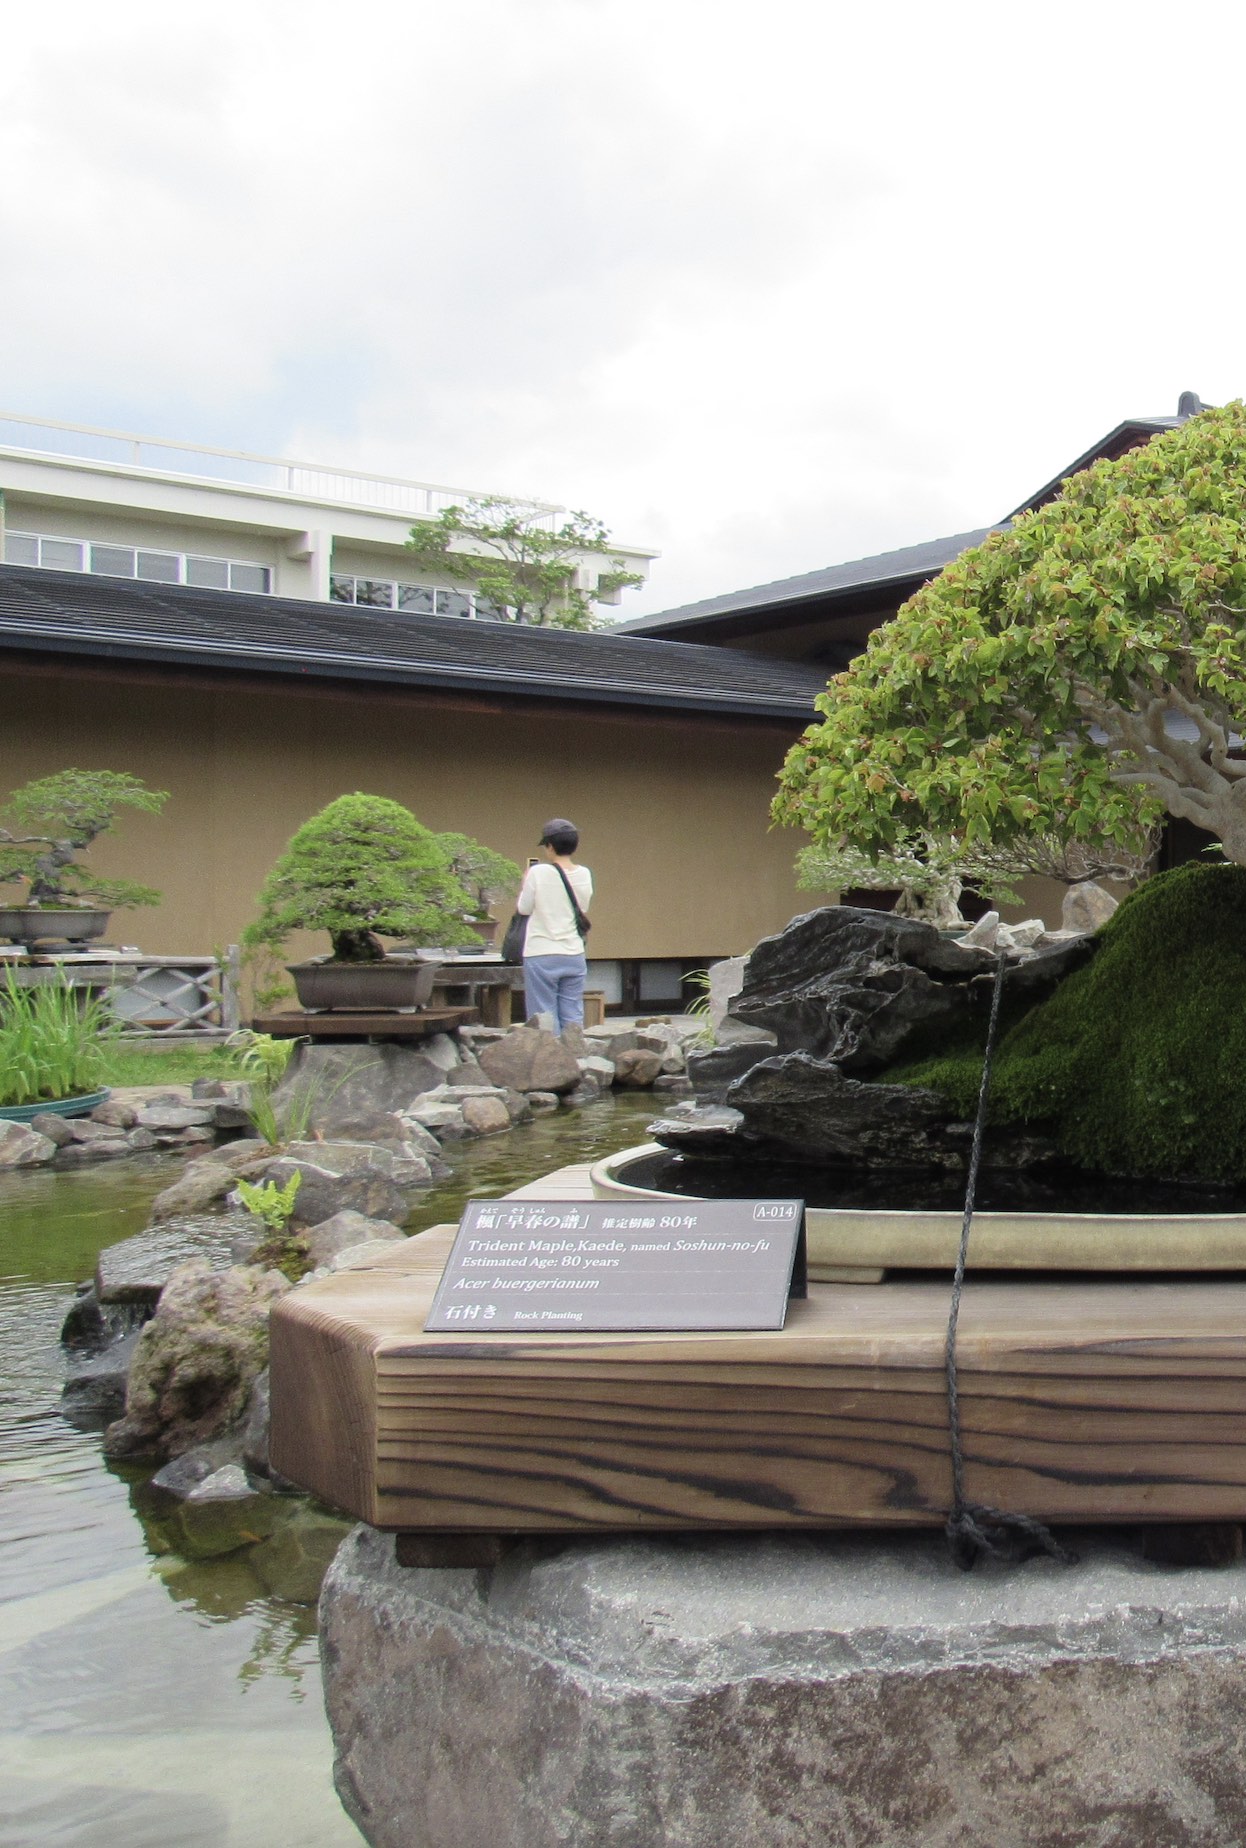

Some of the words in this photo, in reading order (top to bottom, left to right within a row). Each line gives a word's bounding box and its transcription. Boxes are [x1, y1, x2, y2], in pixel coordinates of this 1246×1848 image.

[756, 1206, 794, 1218] A-014
[468, 1240, 525, 1252] Trident
[630, 1242, 671, 1252] named
[673, 1239, 771, 1254] Soshun-no-fu
[461, 1257, 528, 1267] Estimated
[529, 1257, 558, 1269] Age:
[561, 1255, 582, 1267] 80
[583, 1258, 620, 1269] years
[452, 1277, 490, 1289] Acer
[491, 1277, 600, 1292] buergerianum
[445, 1304, 498, 1320] 石付き
[514, 1311, 540, 1320] Rock
[540, 1311, 583, 1321] Planting
